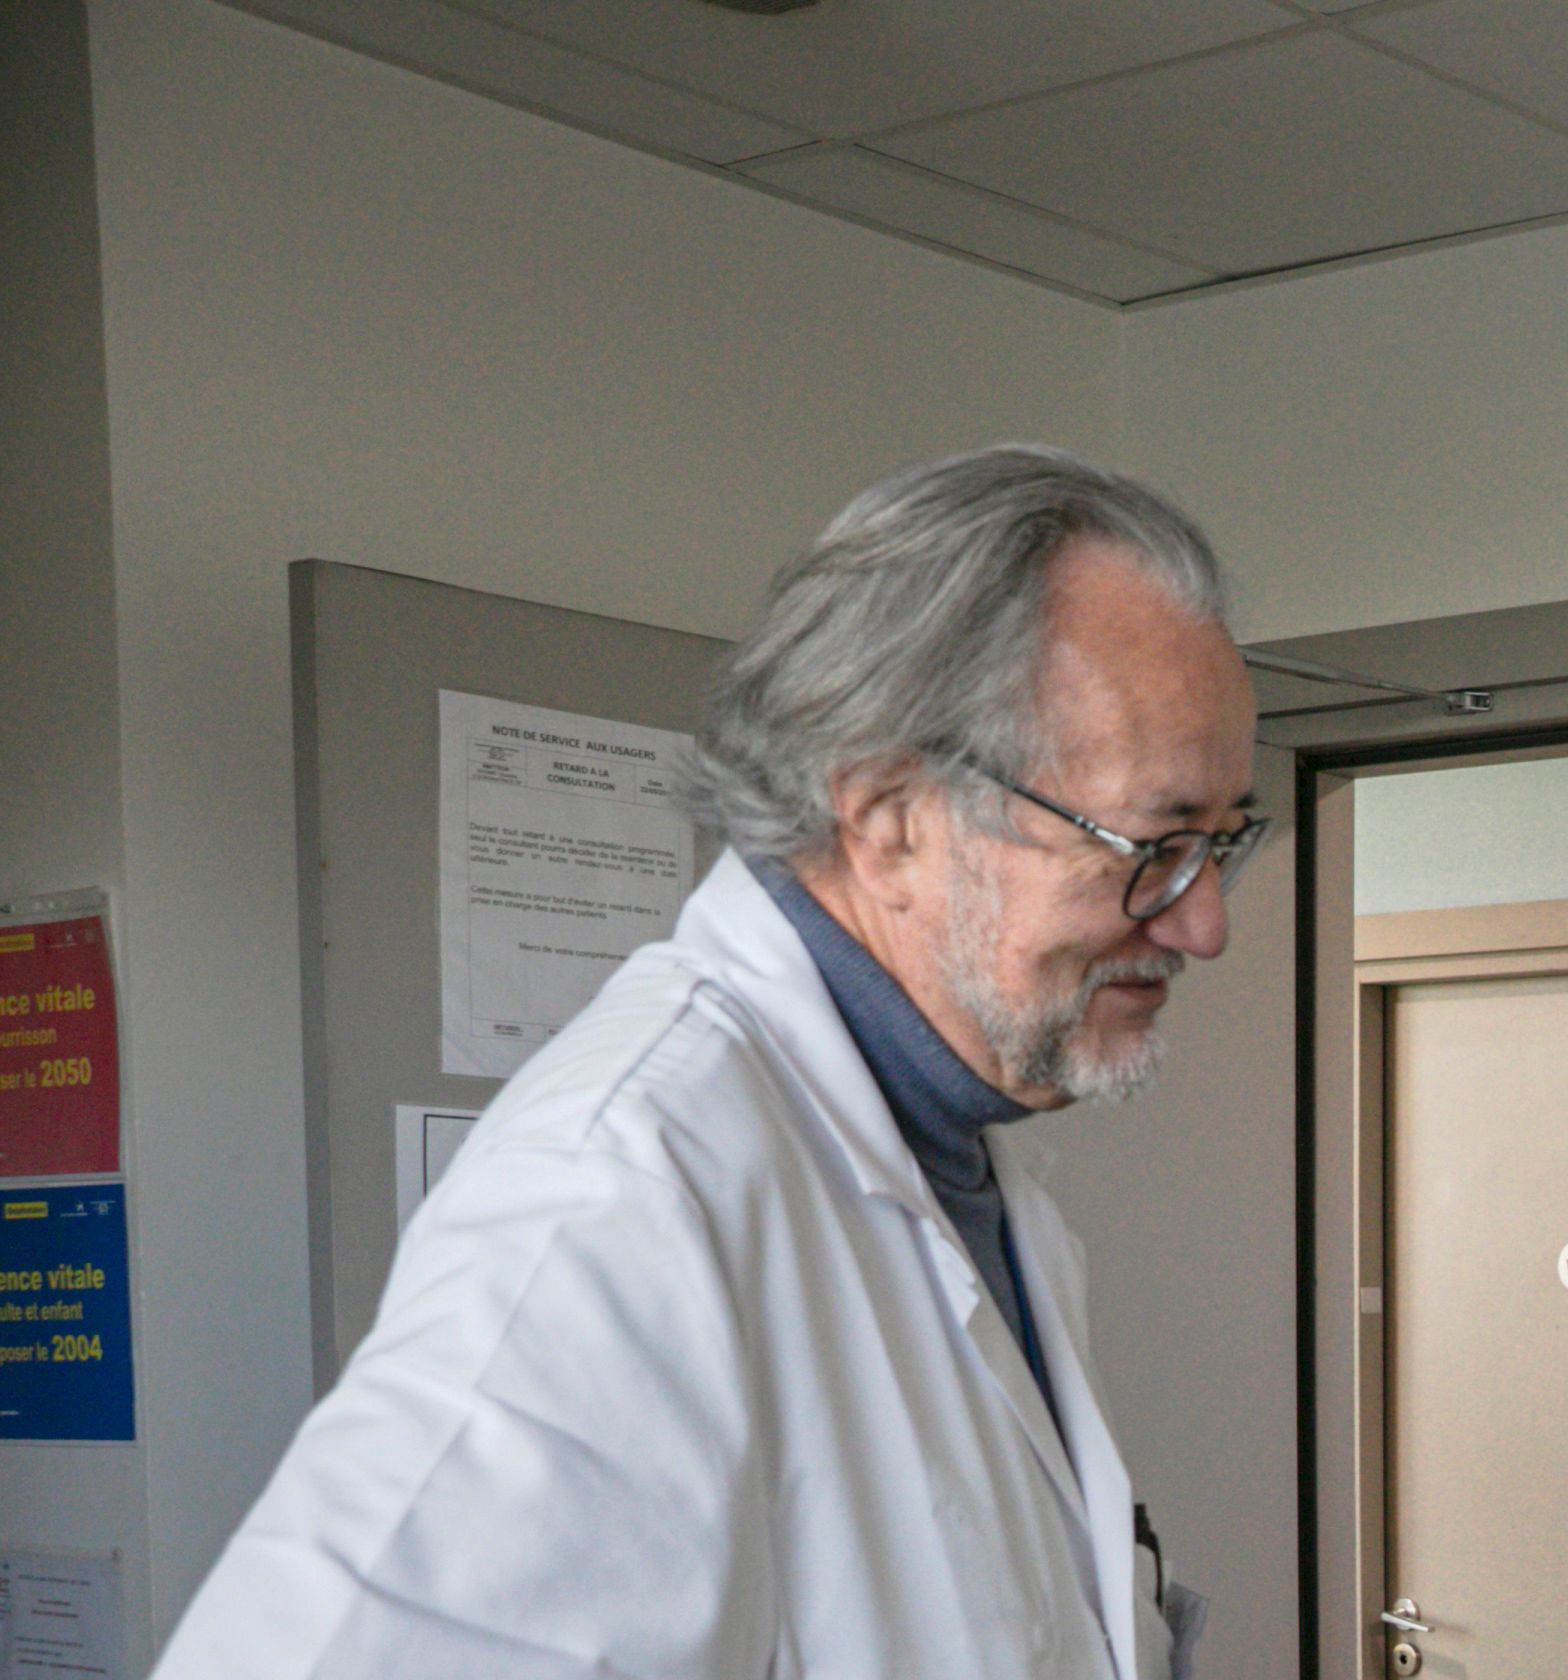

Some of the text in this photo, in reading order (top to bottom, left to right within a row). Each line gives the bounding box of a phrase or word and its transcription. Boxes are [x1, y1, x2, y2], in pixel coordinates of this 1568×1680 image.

[492, 725, 656, 760] NOTE DE SERVICE AUX USAGERS
[547, 774, 616, 791] CONSULTATION
[553, 761, 610, 777] RETARD A LA
[36, 984, 95, 1013] vitale
[24, 1069, 36, 1088] le
[40, 1057, 91, 1088] 2050
[48, 1262, 105, 1290] vitale
[26, 1302, 38, 1321] et
[41, 1300, 84, 1320] enfant
[37, 1340, 48, 1362] le
[52, 1334, 103, 1362] 2004
